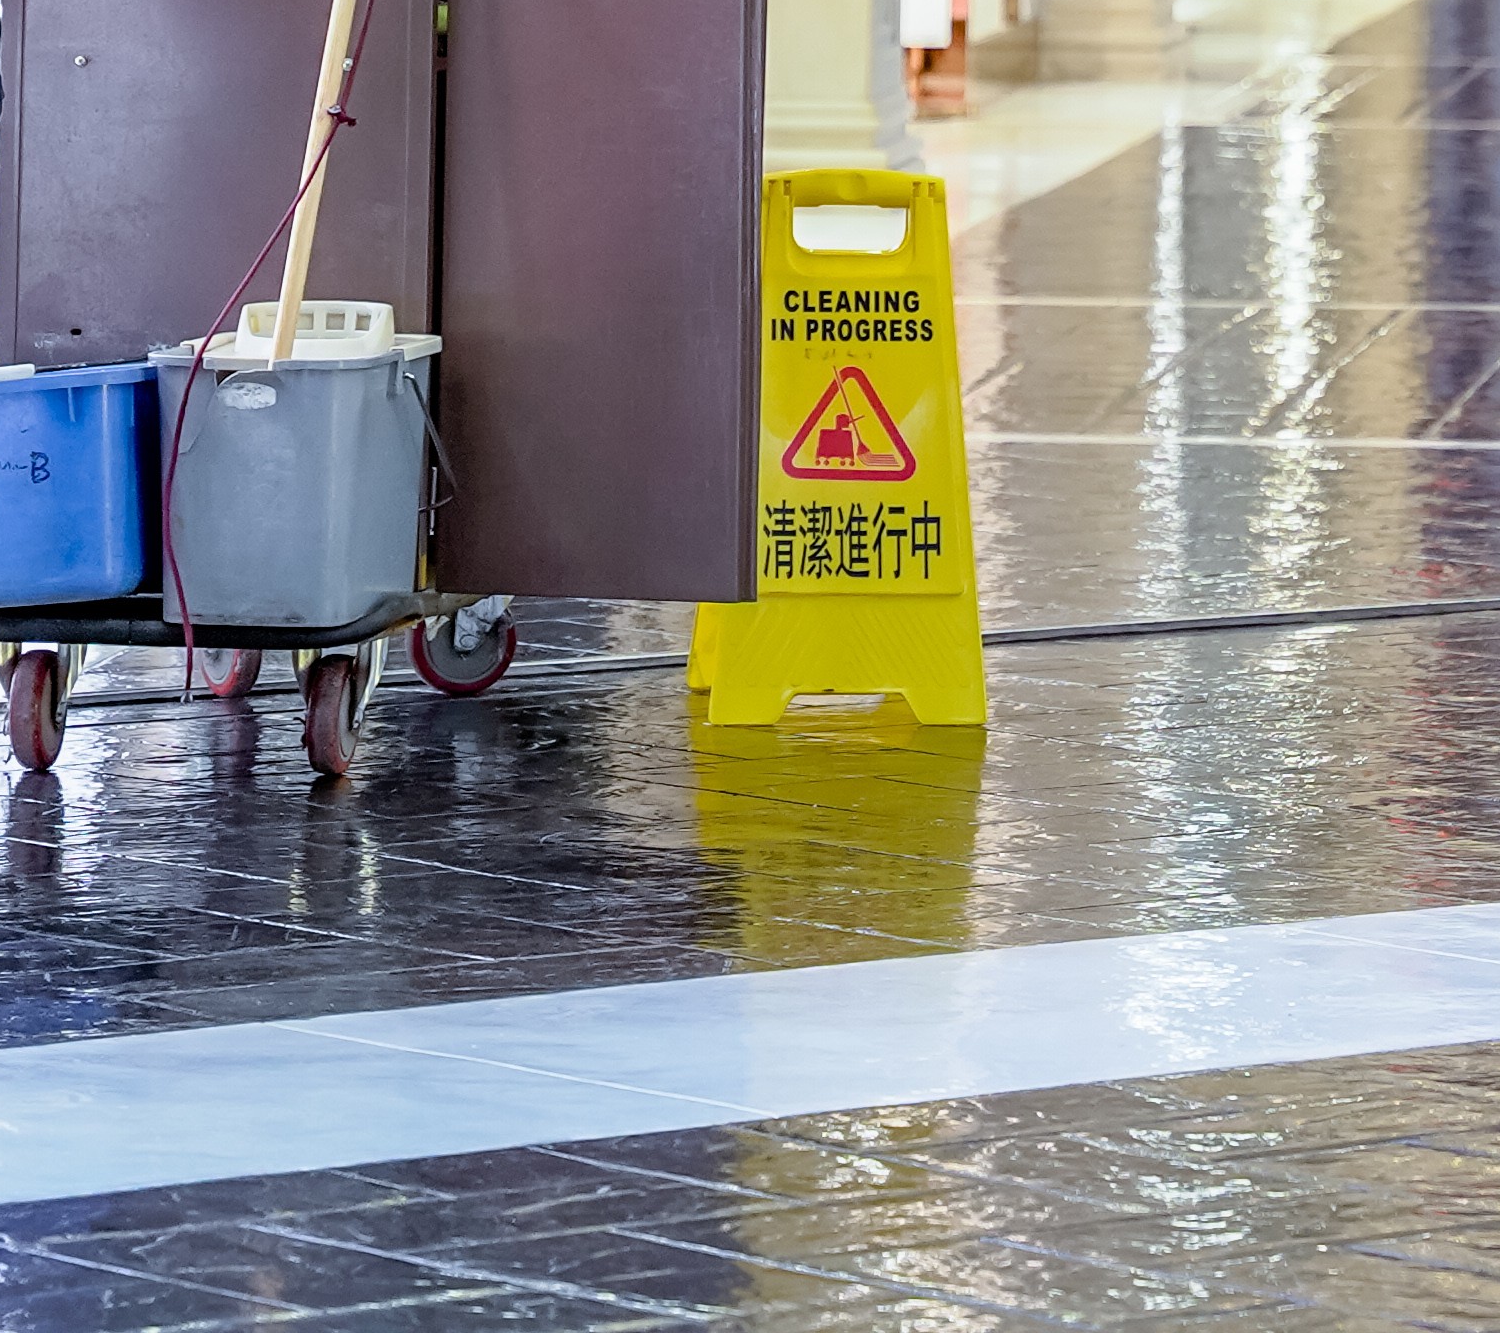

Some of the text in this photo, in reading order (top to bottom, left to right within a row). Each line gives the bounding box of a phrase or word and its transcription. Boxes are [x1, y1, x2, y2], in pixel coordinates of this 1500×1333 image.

[783, 289, 920, 314] CLEANING
[770, 318, 933, 342] IN PROGRESS
[762, 498, 941, 580] 清潔進行中
